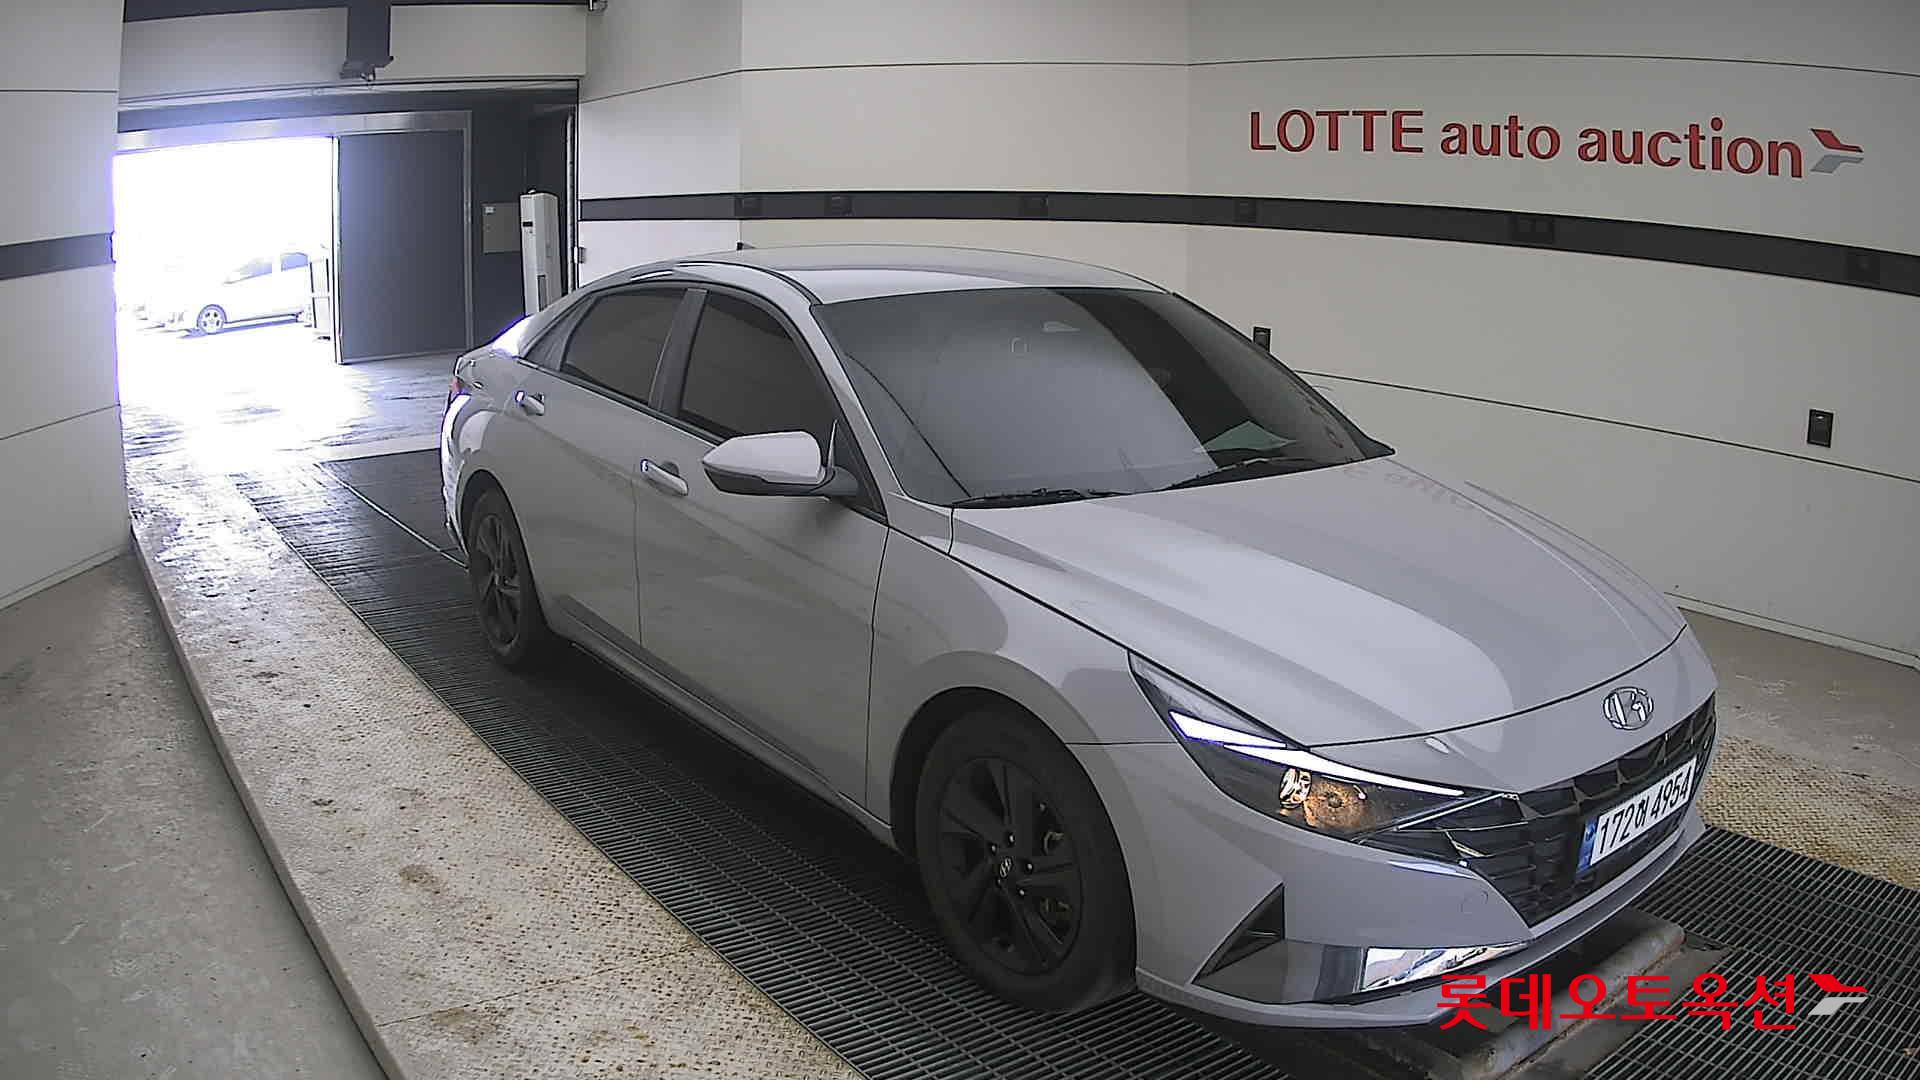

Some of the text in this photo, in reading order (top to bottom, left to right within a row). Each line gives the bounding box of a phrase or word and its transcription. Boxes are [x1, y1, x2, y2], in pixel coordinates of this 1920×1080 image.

[1249, 109, 1804, 178] LOTTE auto auction
[1650, 766, 1693, 820] 4954
